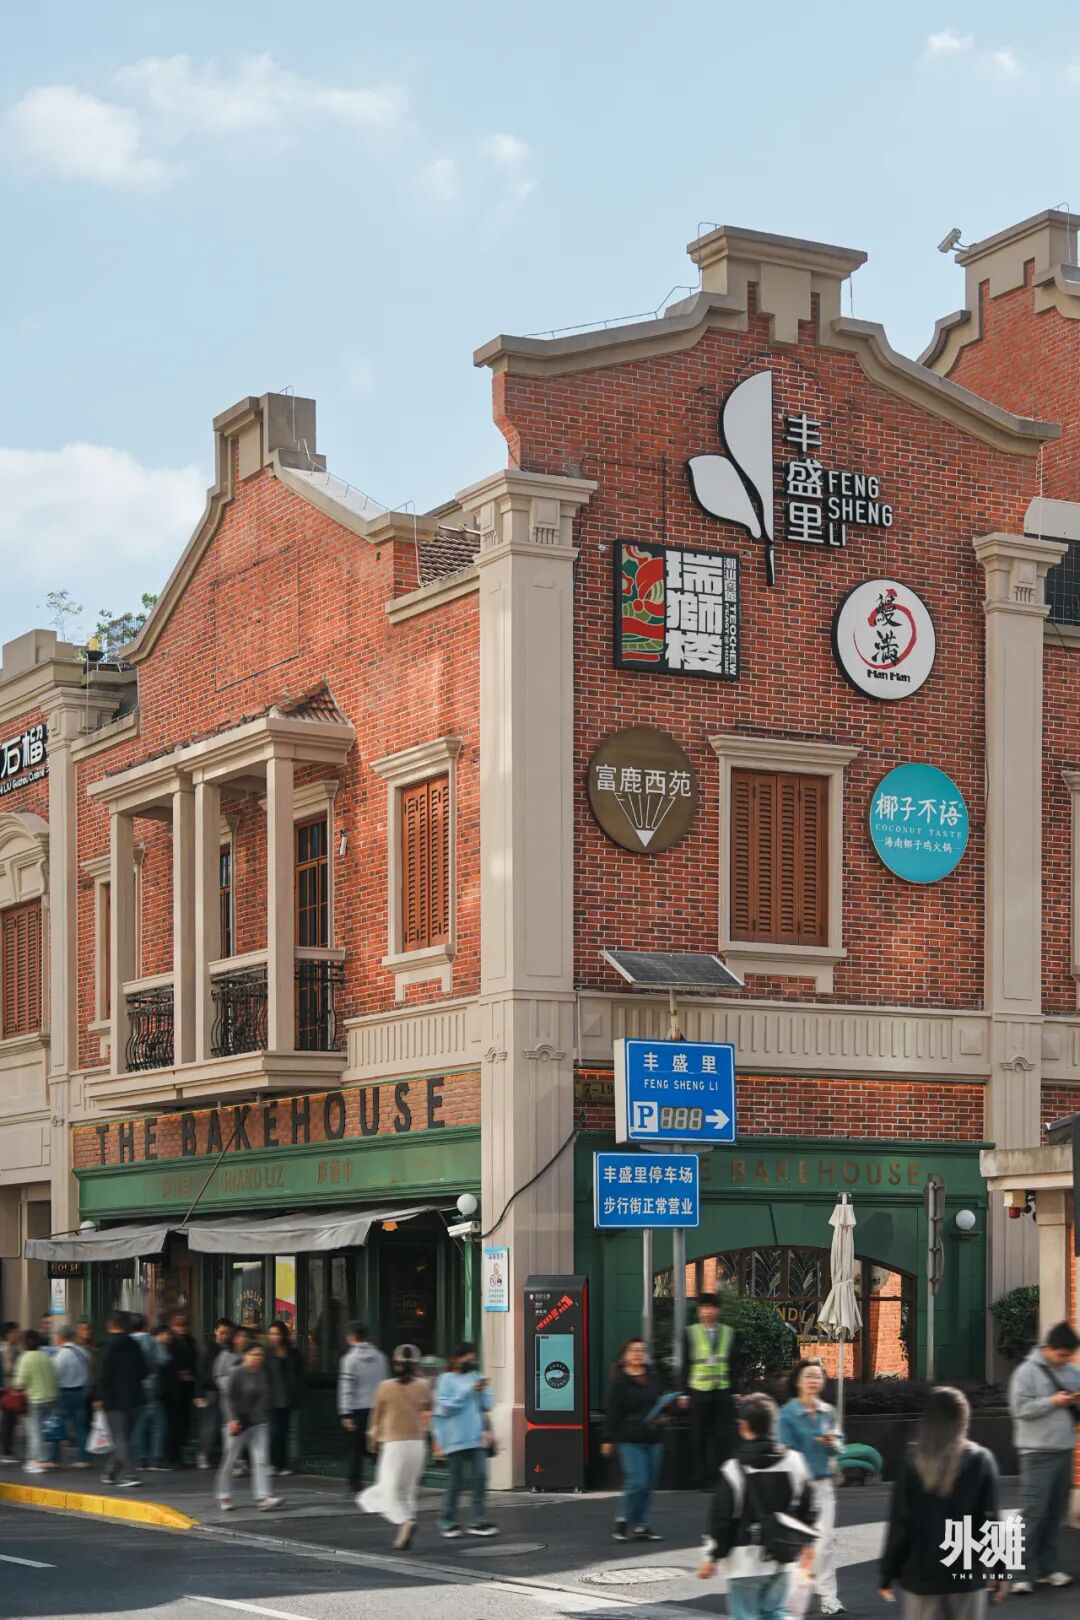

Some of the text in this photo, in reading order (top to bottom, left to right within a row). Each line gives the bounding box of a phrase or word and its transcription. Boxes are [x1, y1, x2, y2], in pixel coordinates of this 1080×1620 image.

[787, 413, 824, 543] 丰盛里
[828, 470, 880, 499] FENG
[828, 497, 893, 527] SHENG
[829, 522, 846, 546] LI
[729, 604, 737, 676] TEOCHEW
[867, 669, 910, 682] Man Man
[596, 764, 692, 797] 富鹿西苑
[875, 793, 963, 826] 椰子不语
[875, 823, 962, 839] COCONUT TASTE
[884, 836, 952, 853] 海南椰子鸡火锅
[643, 1052, 719, 1074] 丰盛里
[644, 1079, 719, 1091] FENG SHENG LI
[96, 1077, 446, 1165] THE BAKEHOUSE
[637, 1105, 654, 1128] P
[603, 1166, 693, 1184] 丰盛里停车场
[731, 1158, 922, 1186] BAKEHOUSE
[603, 1196, 693, 1215] 步行街正常营业
